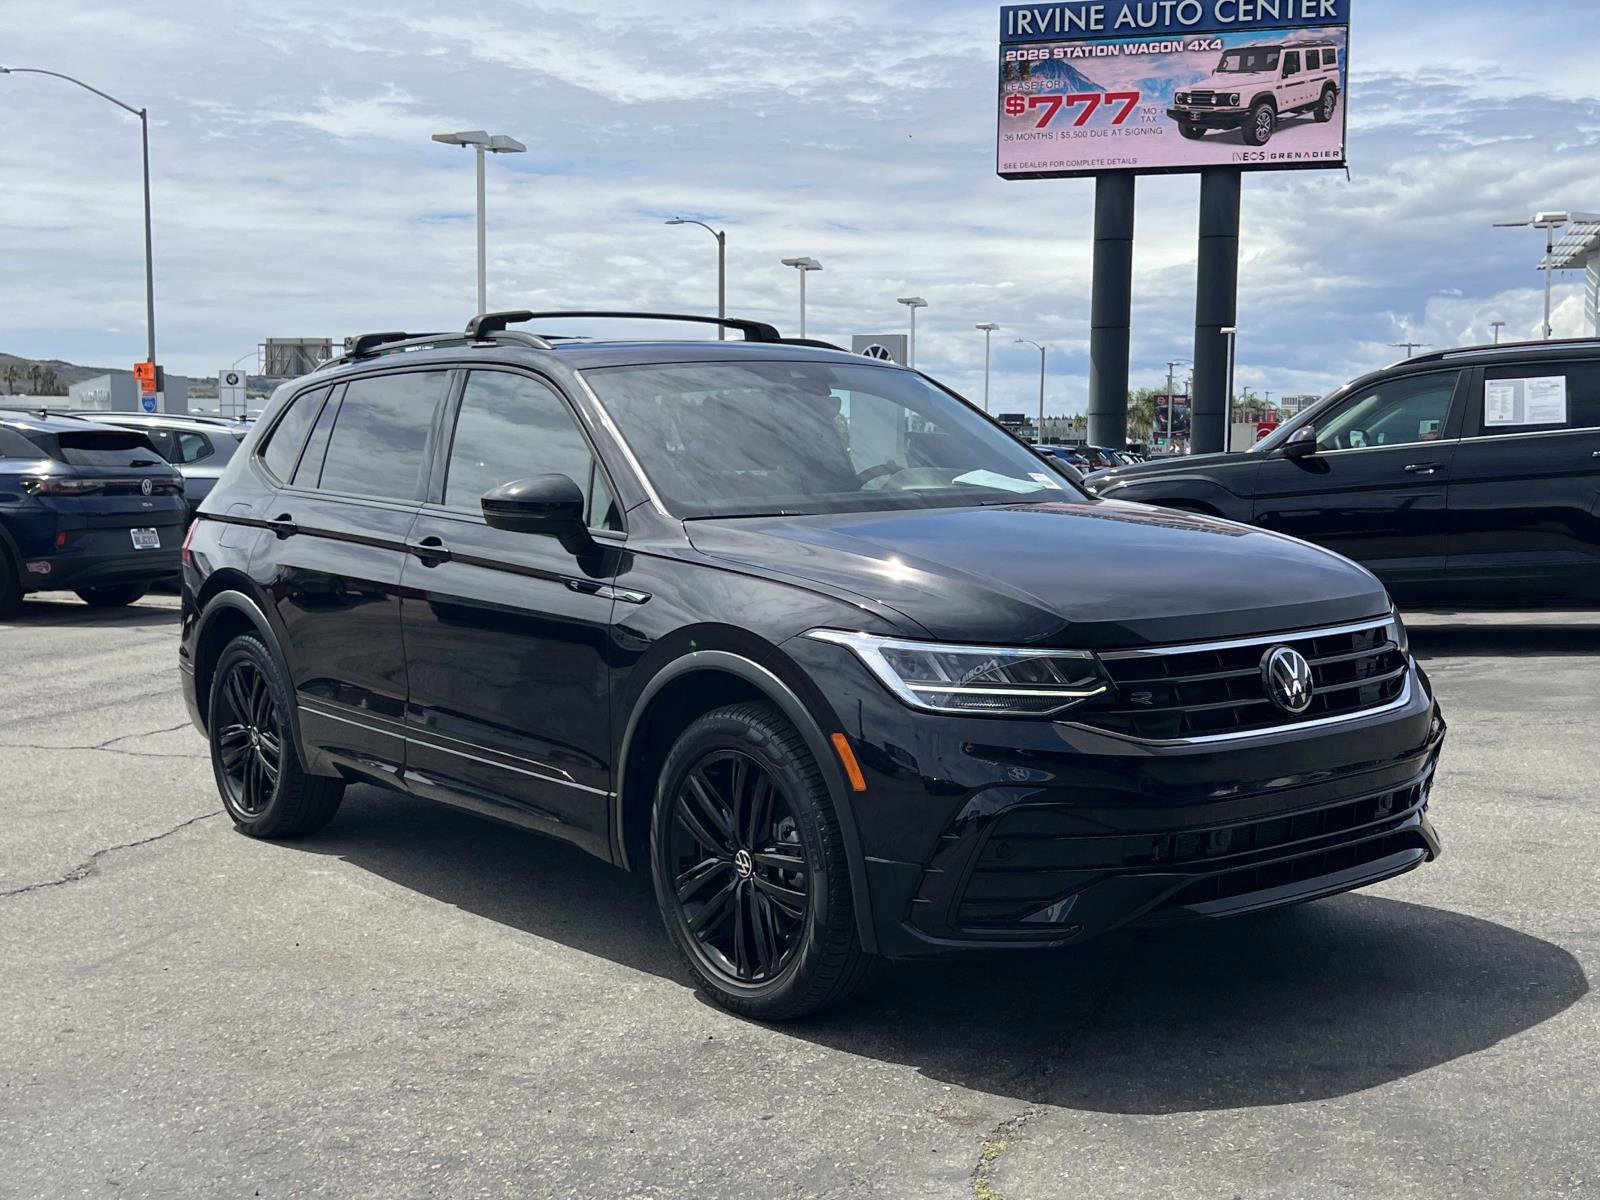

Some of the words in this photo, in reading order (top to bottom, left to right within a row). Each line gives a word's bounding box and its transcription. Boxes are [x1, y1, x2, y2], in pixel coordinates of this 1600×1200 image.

[1008, 5, 1105, 35] IRVINE
[1114, 0, 1203, 29] AUTO
[1214, 0, 1337, 23] CENTER
[1005, 48, 1050, 62] 2026
[1053, 45, 1120, 59] STATION
[1123, 41, 1184, 55] WAGON
[1187, 39, 1223, 51] 4X4
[1005, 81, 1041, 91] LEASE
[1041, 80, 1061, 89] FOR
[1005, 91, 1141, 129] $777
[1141, 116, 1157, 124] TAX
[1004, 133, 1014, 142] 36
[1016, 132, 1054, 141] MONTHS
[1060, 131, 1088, 140] $5,500
[1090, 129, 1108, 138] DUE
[1111, 128, 1122, 137] AT
[1124, 127, 1163, 136] SIGNING
[1003, 162, 1018, 170] SEE
[1049, 160, 1065, 168] FOR
[1066, 159, 1105, 167] COMPLETE
[1107, 157, 1137, 165] DETAILS
[1232, 151, 1266, 162] INEOS
[1270, 151, 1340, 160] GRENADIER
